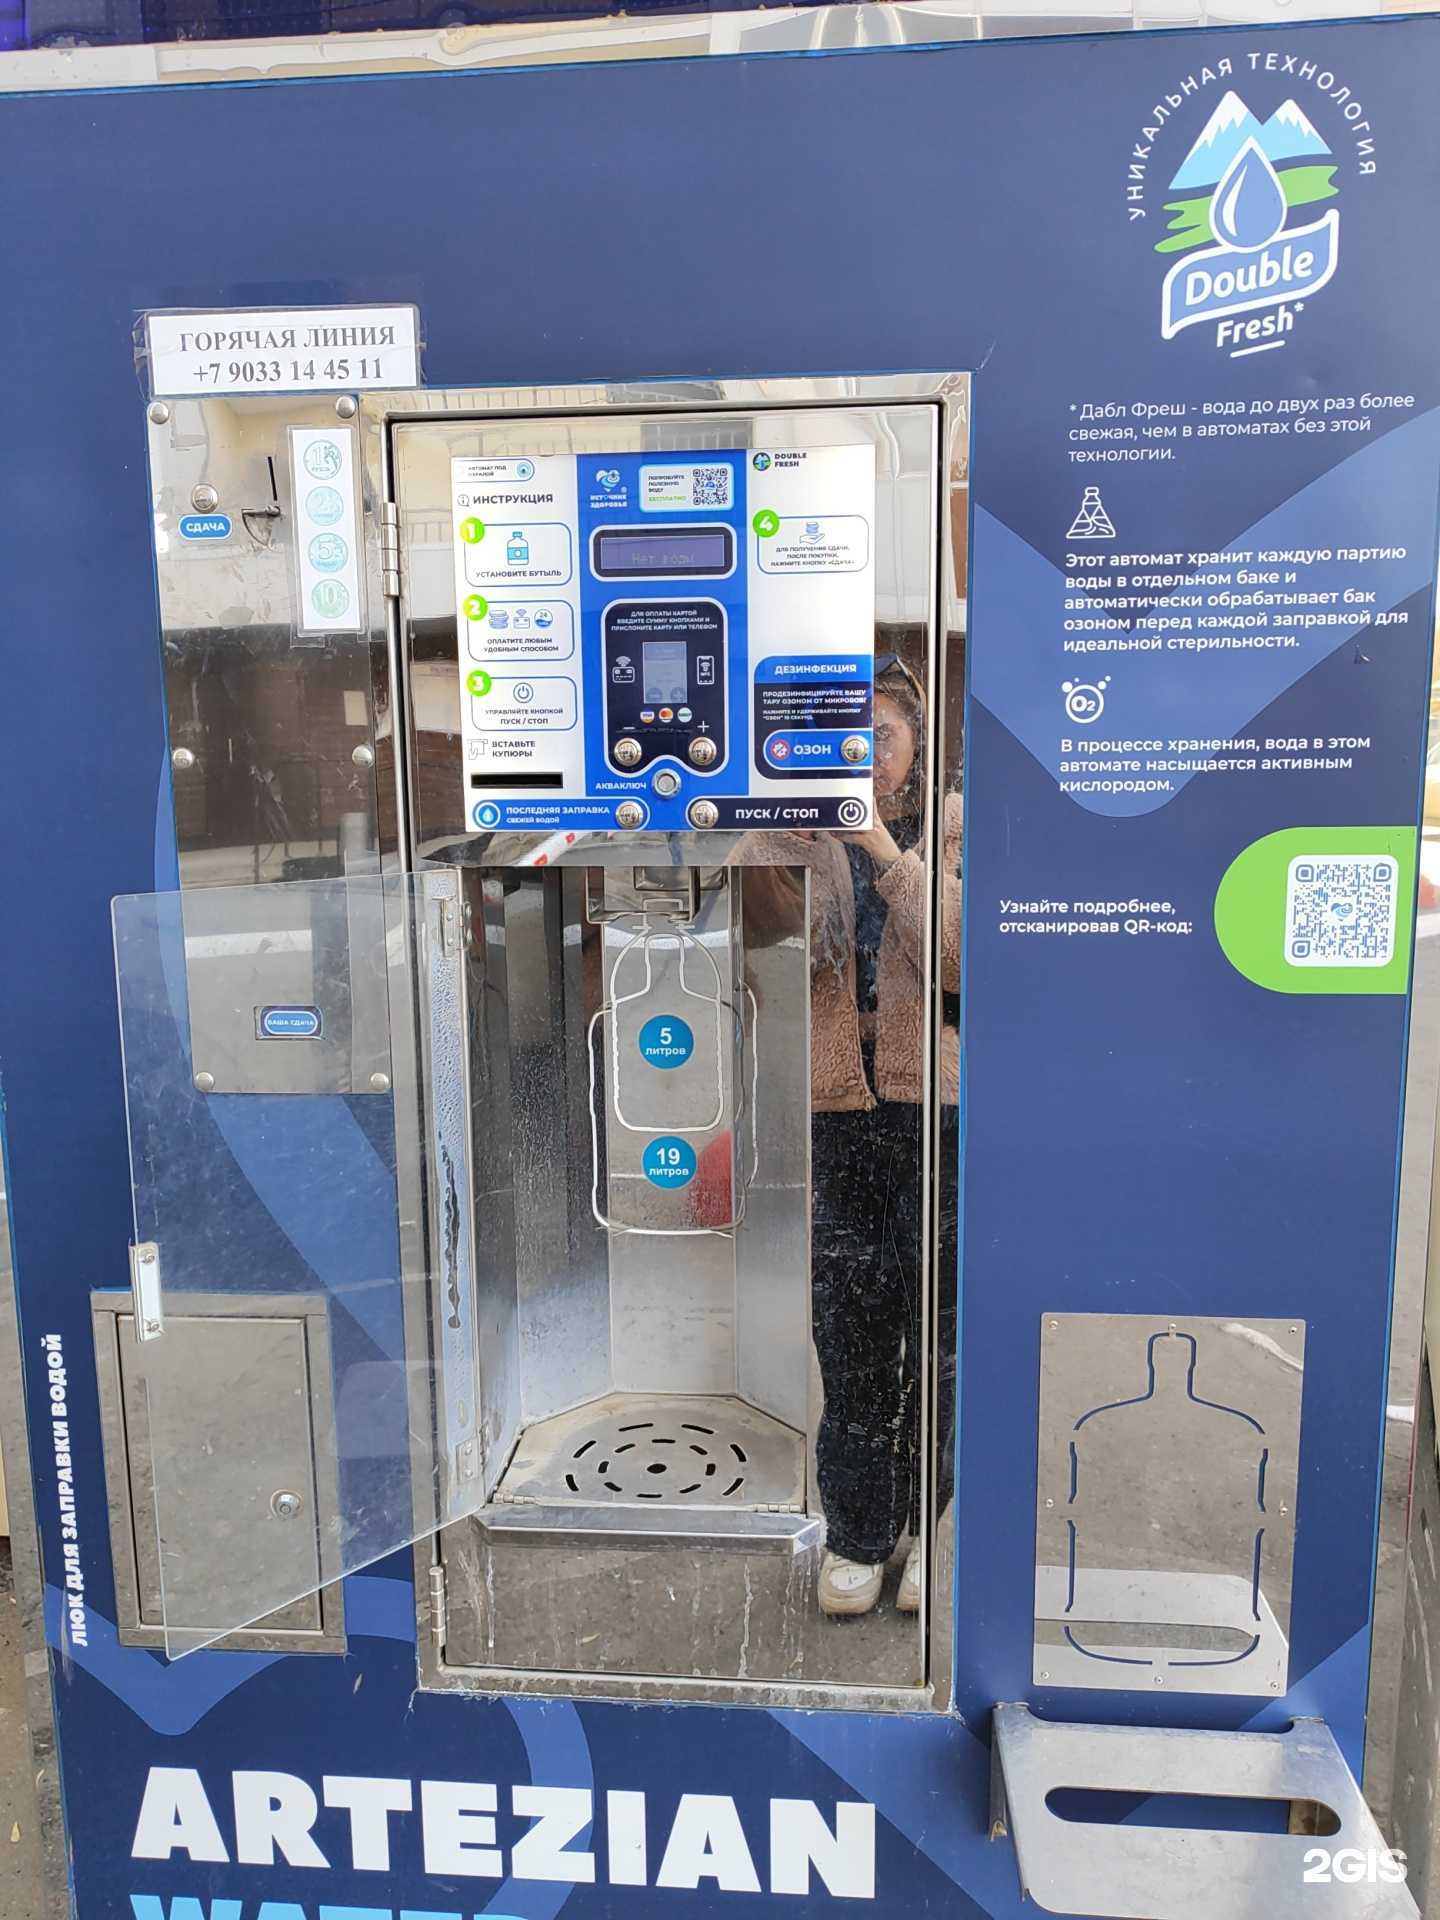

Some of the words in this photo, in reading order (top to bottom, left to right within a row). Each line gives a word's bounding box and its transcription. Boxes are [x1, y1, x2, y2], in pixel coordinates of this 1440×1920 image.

[1127, 58, 1233, 220] УНИКАЛЬНАЯ
[1248, 52, 1376, 175] ТЕХНОЛОГИЯ
[1185, 246, 1314, 306] Double
[179, 329, 296, 352] ГОРЯЧАЯ
[304, 326, 395, 348] ЛИНИЯ
[193, 363, 221, 384] +7
[229, 361, 281, 382] 9033
[291, 360, 315, 381] 14
[324, 359, 350, 380] 45
[360, 358, 383, 379] 11
[1080, 403, 1126, 420] Дабл
[1131, 401, 1186, 418] Фреш
[1202, 400, 1246, 416] вода
[1250, 400, 1273, 415] до
[1277, 399, 1319, 415] двух
[1323, 398, 1355, 413] раз
[1360, 393, 1415, 409] более
[1069, 426, 1138, 443] свежая,
[1142, 425, 1177, 439] чем
[1183, 424, 1192, 437] в
[1197, 421, 1290, 437] автоматах
[1294, 417, 1326, 433] без
[1330, 416, 1371, 433] этой
[774, 452, 807, 460] DOUBLE
[774, 460, 800, 468] FRESH
[1069, 447, 1175, 463] технологии.
[473, 493, 554, 505] ИНСТРУКЦИЯ
[186, 522, 225, 534] СДАЧА
[758, 515, 773, 532] 4
[1065, 552, 1106, 568] Этот
[1109, 552, 1183, 567] автомат
[1187, 549, 1253, 568] хранит
[1257, 548, 1332, 567] каждую
[1336, 545, 1407, 564] партию
[475, 570, 527, 578] УСТАНОВИТЕ
[1065, 575, 1112, 590] воды
[1117, 574, 1127, 587] в
[1132, 571, 1231, 589] отдельном
[1236, 569, 1280, 585] баке
[1285, 571, 1297, 584] и
[1064, 595, 1203, 611] автоматически
[1207, 589, 1339, 609] обрабатывает
[1343, 588, 1376, 604] бак
[1064, 617, 1131, 631] озоном
[1136, 615, 1192, 634] перед
[1197, 611, 1268, 630] каждой
[1272, 609, 1370, 630] заправкой
[1374, 612, 1409, 627] для
[1064, 635, 1162, 653] идеальной
[1167, 635, 1300, 652] стерильности.
[774, 664, 857, 675] ДЕЗИНФЕКЦИЯ
[491, 740, 536, 748] ВСТАВЬТЕ
[793, 744, 832, 755] ОЗОН
[1061, 738, 1073, 753] В
[1077, 738, 1163, 757] процессе
[1168, 737, 1260, 756] хранения,
[1265, 736, 1308, 752] вода
[1313, 736, 1324, 750] в
[1328, 735, 1371, 749] этом
[492, 750, 533, 758] КУПЮРЫ
[1060, 758, 1141, 773] автомате
[1146, 757, 1256, 773] насыщается
[1261, 756, 1352, 770] активным
[595, 782, 647, 790] АКВАКЛЮЧ
[1060, 777, 1174, 795] кислородом.
[506, 806, 561, 816] ПОСЛЕДНЯЯ
[562, 806, 610, 815] ЗАПРАВКА
[535, 816, 560, 824] ВОДОЙ
[735, 808, 772, 820] ПУСК
[782, 808, 820, 819] СТОП
[1000, 897, 1068, 916] Узнайте
[1073, 897, 1176, 918] подробнее,
[1000, 918, 1119, 937] отсканировав
[1124, 917, 1193, 936] QR-код:
[660, 1027, 672, 1045] 5
[645, 1046, 686, 1056] литров
[656, 1148, 680, 1165] 19
[648, 1167, 689, 1176] литров
[41, 1334, 67, 1417] ВОДОЙ
[53, 1421, 78, 1540] ЗАПРАВКИ
[64, 1543, 84, 1591] ДЛЯ
[67, 1594, 88, 1647] ЛЮК
[130, 1766, 876, 1899] ARTEZIAN
